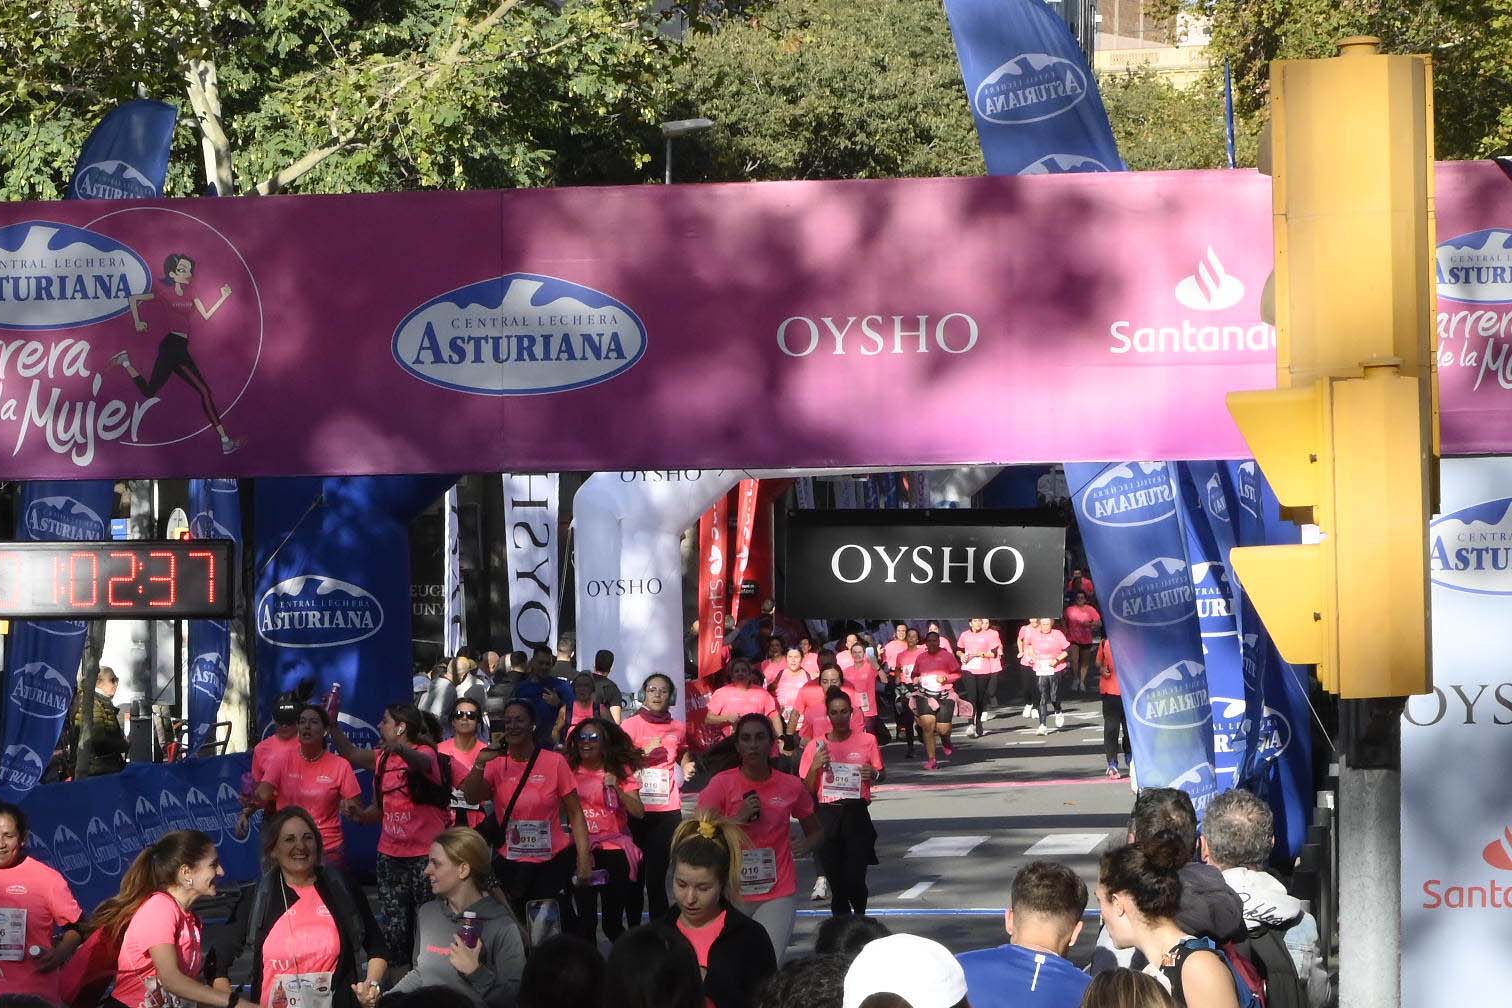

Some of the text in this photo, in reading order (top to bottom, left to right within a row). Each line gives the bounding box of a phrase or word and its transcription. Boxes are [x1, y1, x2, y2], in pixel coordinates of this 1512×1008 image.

[54, 257, 127, 269] LECHERA
[451, 314, 619, 329] CENTRAL LECHERA
[776, 313, 979, 357] OYSHO
[412, 321, 627, 365] ASTURIANA
[1459, 339, 1478, 367] la
[13, 373, 161, 467] Mujer
[830, 542, 1025, 585] OYSHO
[586, 577, 663, 598] OYSHO
[261, 604, 374, 632] ASTURIANA
